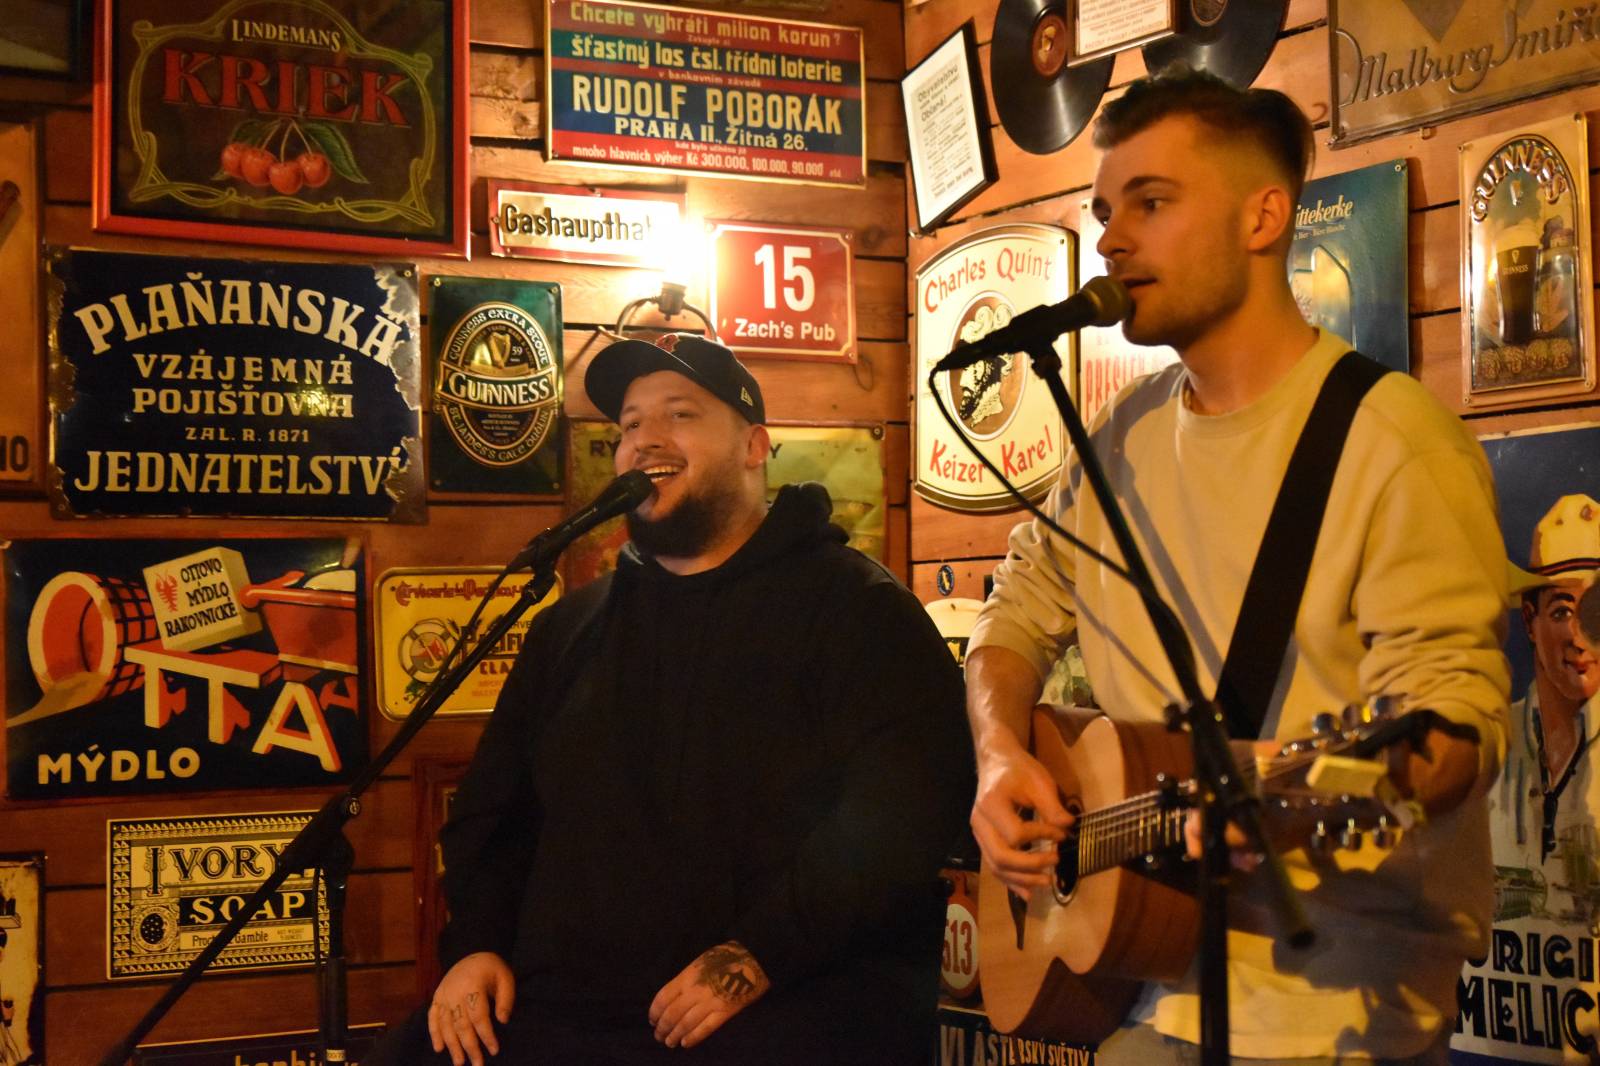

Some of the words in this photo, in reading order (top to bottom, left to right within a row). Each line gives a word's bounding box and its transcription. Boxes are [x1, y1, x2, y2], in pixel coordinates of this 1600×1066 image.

[232, 19, 342, 53] LINDEMANS
[570, 2, 635, 27] Chcete
[643, 12, 708, 35] vyhráti
[718, 22, 771, 41] milion
[571, 35, 650, 69] šťastný
[656, 41, 684, 67] los
[781, 58, 843, 83] loterie
[162, 48, 414, 128] KRIEK
[572, 74, 687, 121] RUDOLF
[707, 86, 843, 136] POBORÁK
[615, 116, 694, 142] PRAHA
[726, 122, 778, 149] Žitná
[572, 145, 607, 159] mnoho
[609, 145, 651, 162] hlavních
[654, 149, 683, 166] výher
[1470, 143, 1568, 223] GUINNESS
[1295, 194, 1354, 226] ittekerke
[754, 244, 816, 312] 15
[925, 257, 986, 314] Charles
[997, 248, 1053, 282] Quint
[734, 318, 794, 341] Zach's
[801, 321, 837, 342] Pub
[132, 348, 354, 385] VZÁJEMNÁ
[132, 383, 354, 418] POJIŠŤOVNA
[449, 373, 550, 405] GUINNESS
[185, 426, 236, 442] ZAL.
[242, 428, 262, 442] R.
[268, 429, 310, 444] 1871
[929, 439, 986, 483] Keizer
[1001, 424, 1053, 479] Karel
[180, 557, 223, 585] OTTOVO
[164, 600, 239, 638] RAKOVNICKÉ
[38, 744, 201, 785] MÝDLO
[144, 842, 291, 897] IVORY
[189, 892, 306, 925] SOAP
[1465, 929, 1600, 983] RIGI
[1455, 975, 1600, 1055] MELIC
